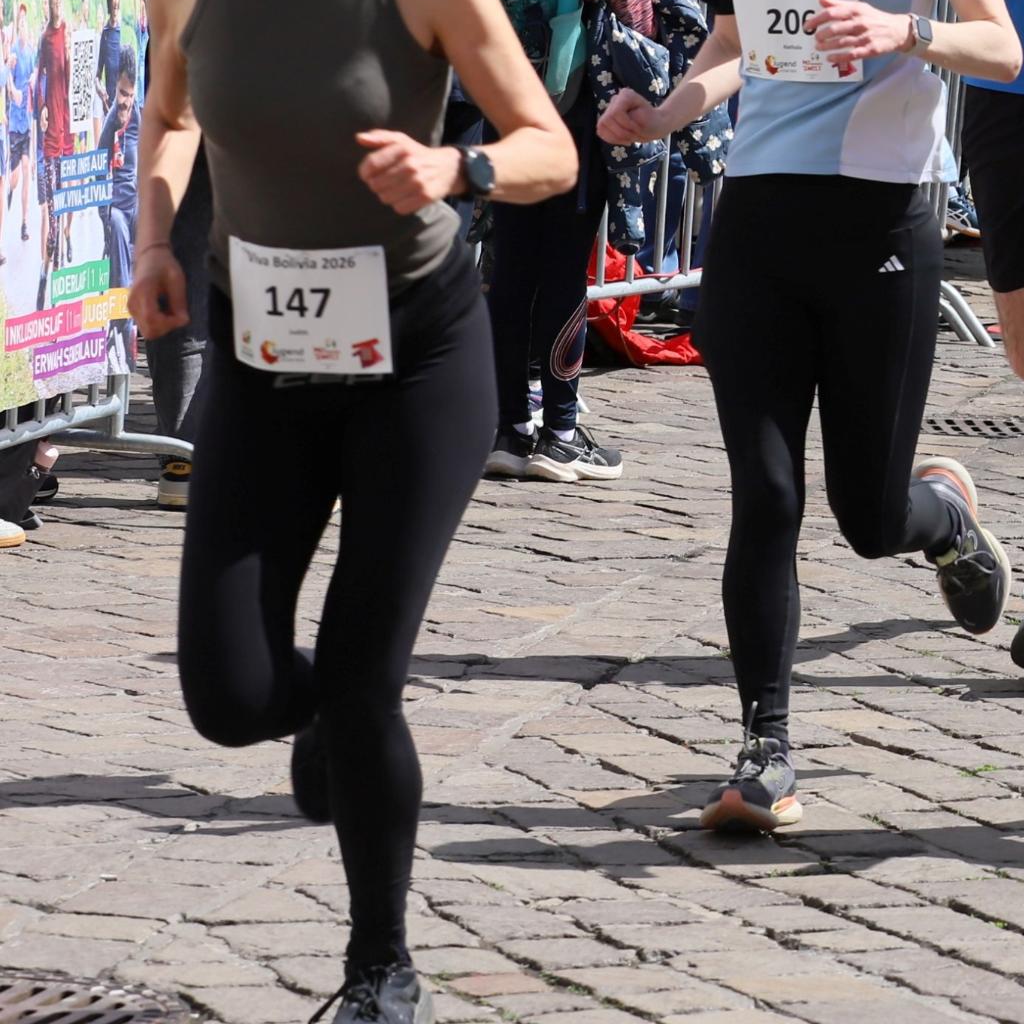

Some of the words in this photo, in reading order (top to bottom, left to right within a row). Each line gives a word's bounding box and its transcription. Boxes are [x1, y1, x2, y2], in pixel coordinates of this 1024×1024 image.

[91, 153, 108, 172] AUF
[248, 252, 269, 267] Viva
[273, 256, 318, 270] Bolivia
[322, 256, 356, 270] 2026
[265, 285, 331, 319] 147
